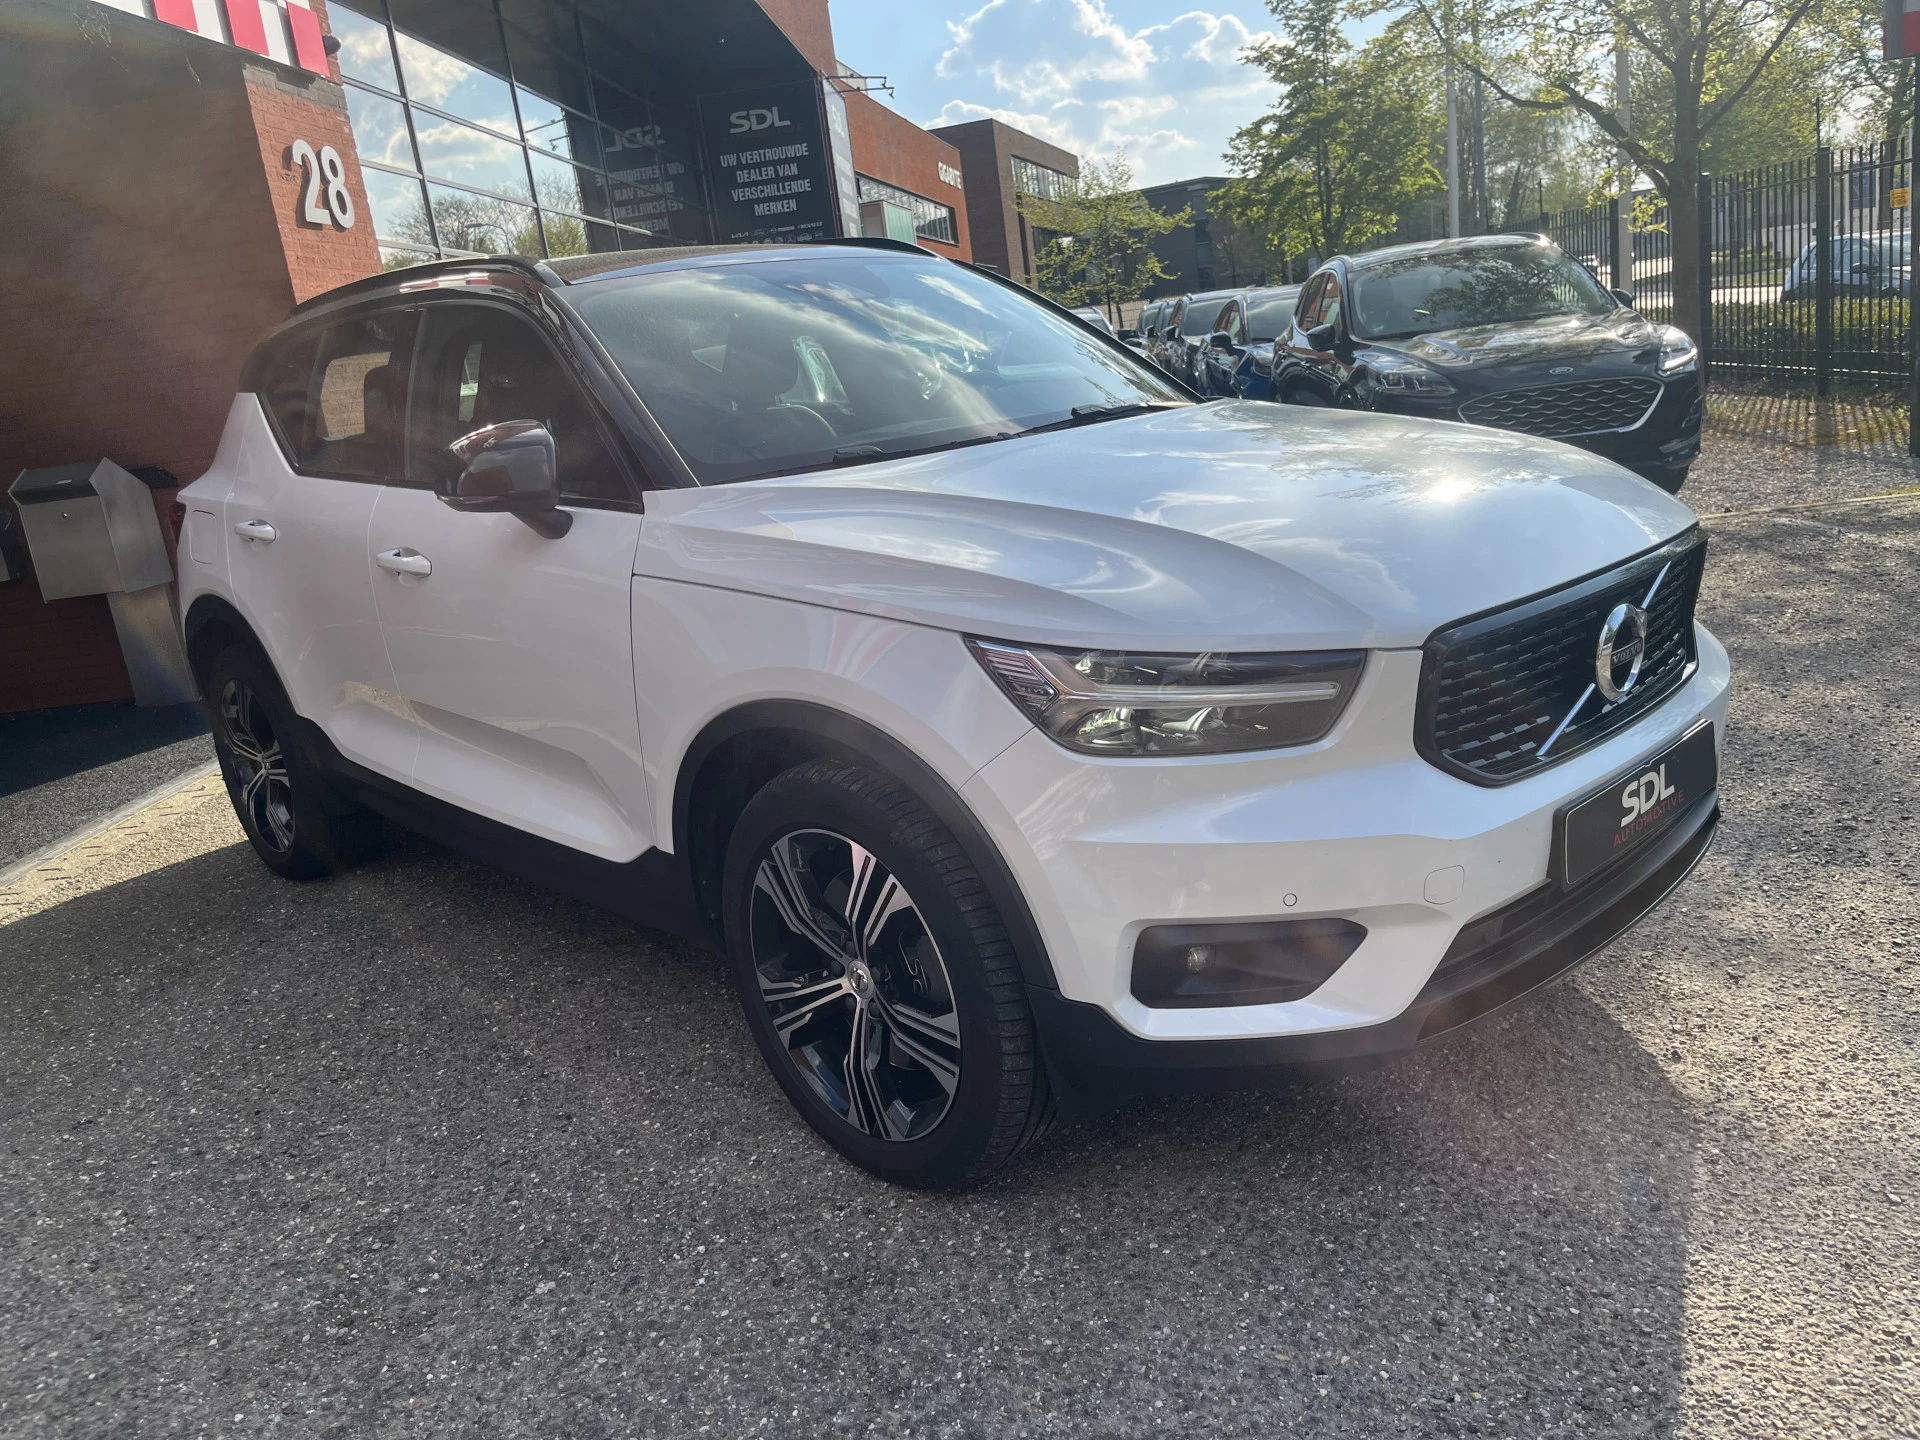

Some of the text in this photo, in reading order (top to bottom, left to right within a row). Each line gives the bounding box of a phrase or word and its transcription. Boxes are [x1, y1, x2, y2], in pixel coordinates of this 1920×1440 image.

[729, 106, 791, 134] SDL
[720, 142, 809, 167] UW VERTROUWDE
[292, 139, 356, 229] 28
[736, 162, 799, 184] DEALER VAN
[731, 179, 812, 202] VERSCHILLENDE
[754, 199, 798, 217] MERKEN
[1612, 642, 1642, 664] VOLVO
[1620, 763, 1676, 828] SDL
[1613, 789, 1686, 847] AUTOMOTIVE
